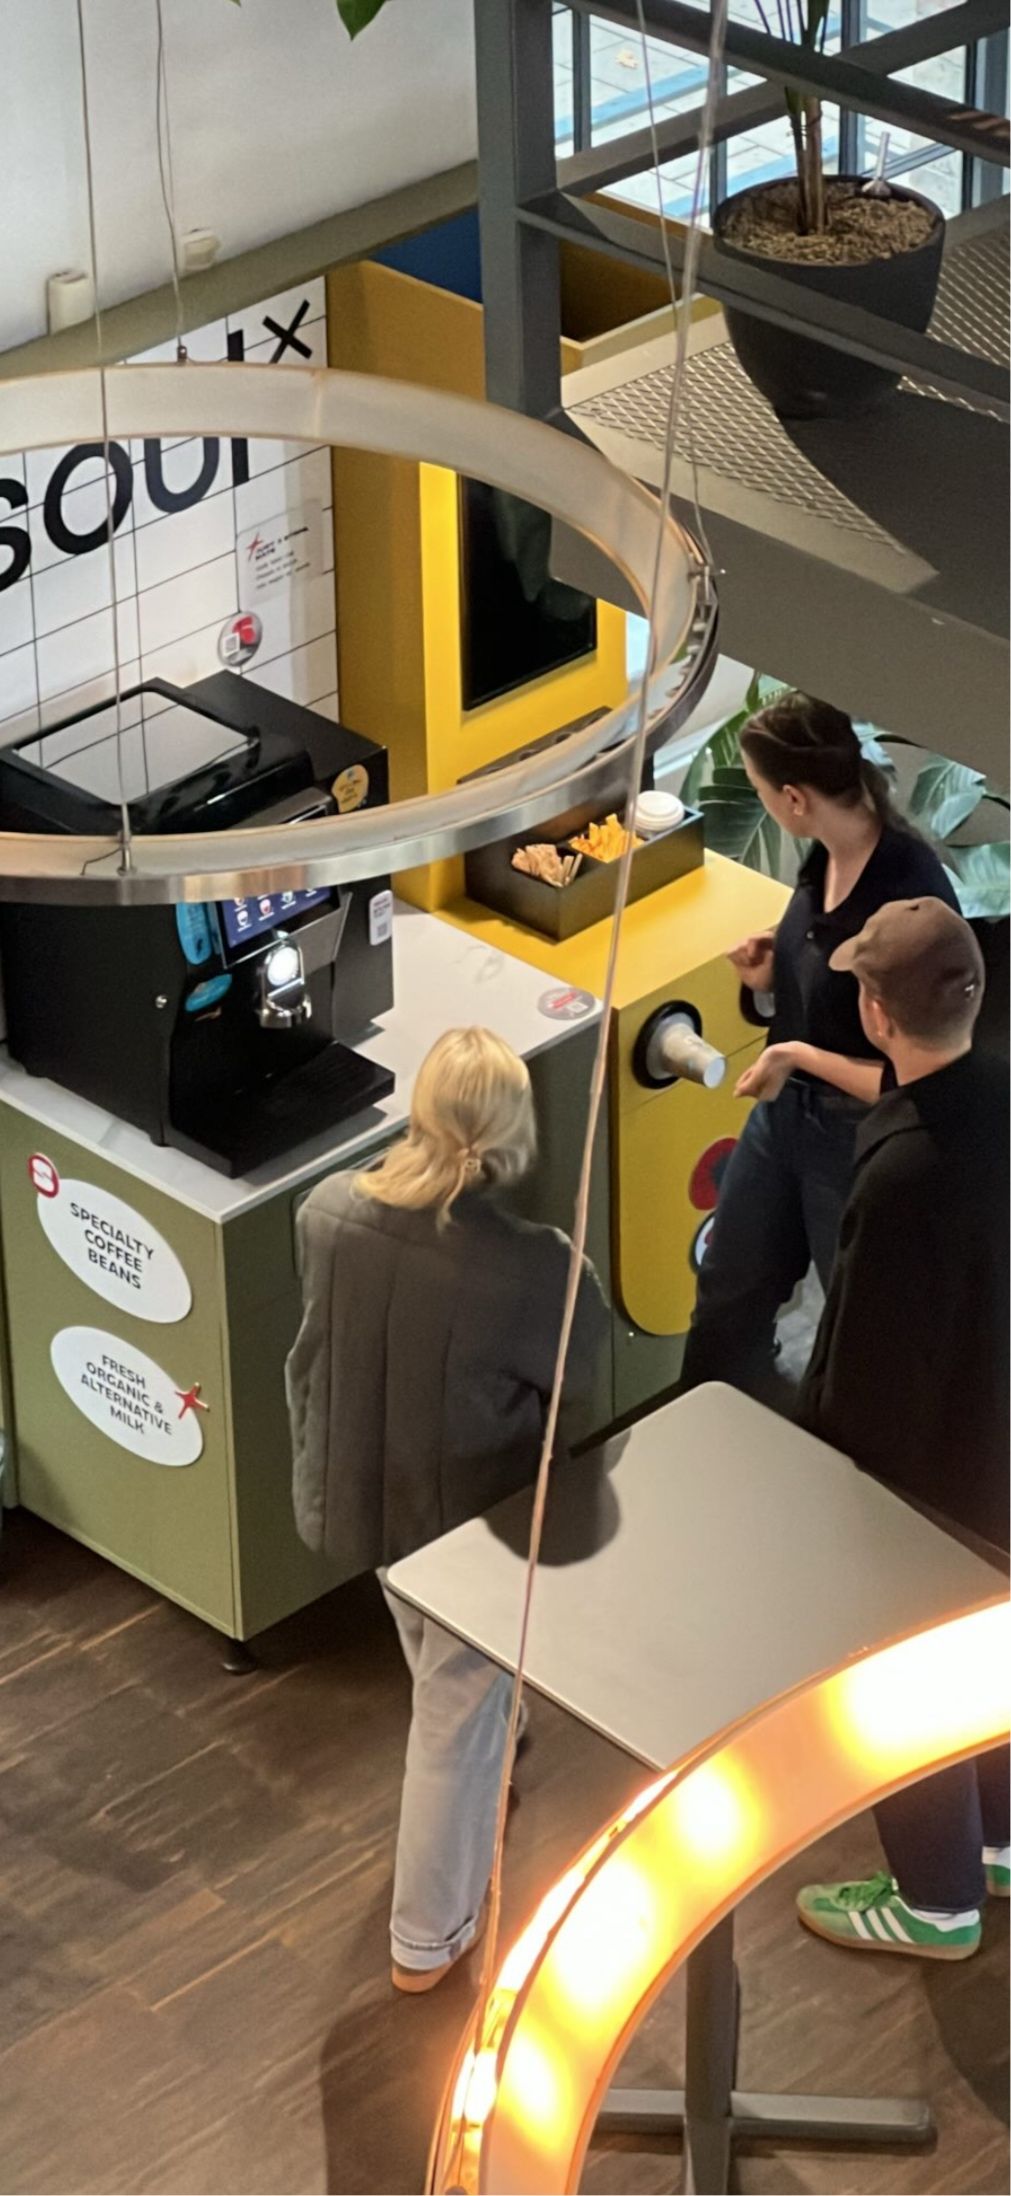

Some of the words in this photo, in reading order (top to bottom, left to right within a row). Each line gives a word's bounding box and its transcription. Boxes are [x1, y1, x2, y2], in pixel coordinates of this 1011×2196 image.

[70, 1202, 154, 1260] SPECIALTY
[84, 1229, 142, 1273] COFFEE
[88, 1248, 141, 1290] BEANS
[86, 1361, 150, 1407] ORGANIC
[154, 1401, 163, 1414] &
[102, 1354, 146, 1389] FRESH
[81, 1374, 173, 1435] ALTERNATIVE
[110, 1405, 145, 1434] MILK
